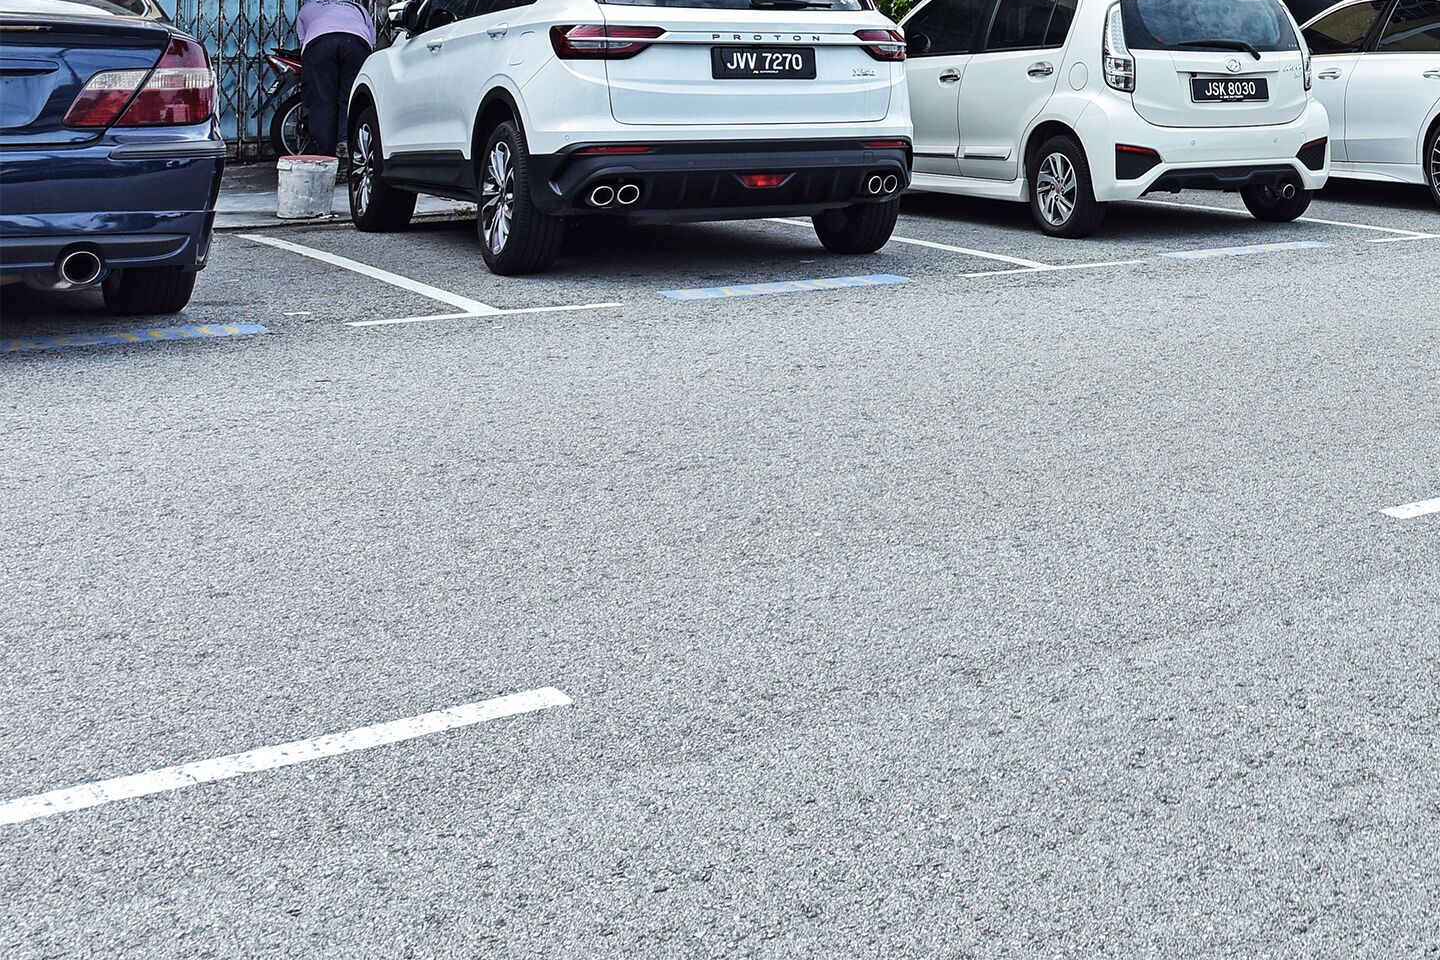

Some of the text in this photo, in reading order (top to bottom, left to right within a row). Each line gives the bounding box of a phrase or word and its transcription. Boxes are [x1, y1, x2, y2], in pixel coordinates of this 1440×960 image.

[727, 52, 803, 70] JVV 7270
[1205, 82, 1227, 96] JSK
[1227, 81, 1256, 96] 8030
